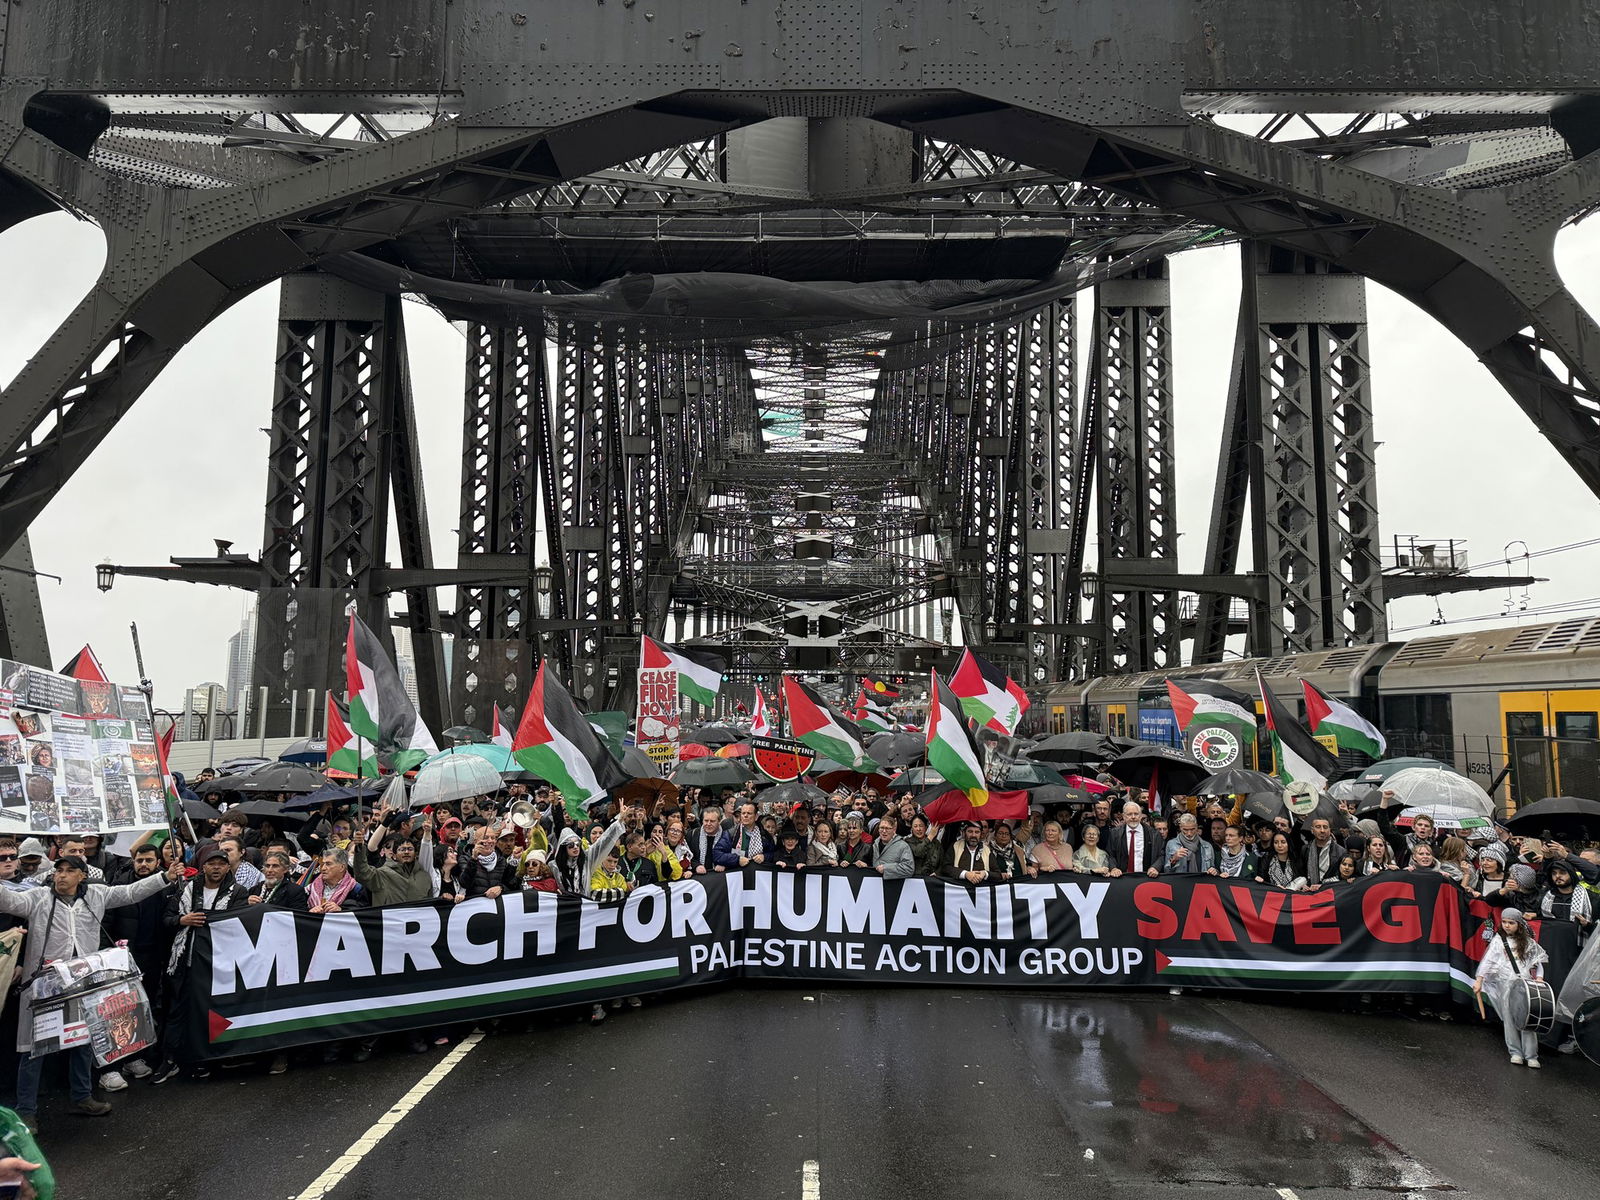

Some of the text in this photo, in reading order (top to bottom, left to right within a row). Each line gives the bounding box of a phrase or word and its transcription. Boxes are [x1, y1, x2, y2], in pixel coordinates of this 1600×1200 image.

[640, 671, 677, 684] CEASE
[640, 684, 677, 702] FIRE
[752, 739, 770, 747] FREE
[1194, 733, 1207, 746] FREE
[1206, 729, 1237, 748] PALESTINE
[648, 746, 669, 754] STOP
[1194, 747, 1206, 762] END
[1204, 747, 1237, 767] APARTHEID
[208, 892, 558, 996] MARCH
[577, 879, 713, 951] FOR
[726, 871, 1110, 940] HUMANITY
[1133, 881, 1342, 945] SAVE
[690, 939, 1143, 976] PALESTINE ACTION GROUP
[97, 989, 138, 1015] ARREST
[105, 1050, 120, 1063] WAR
